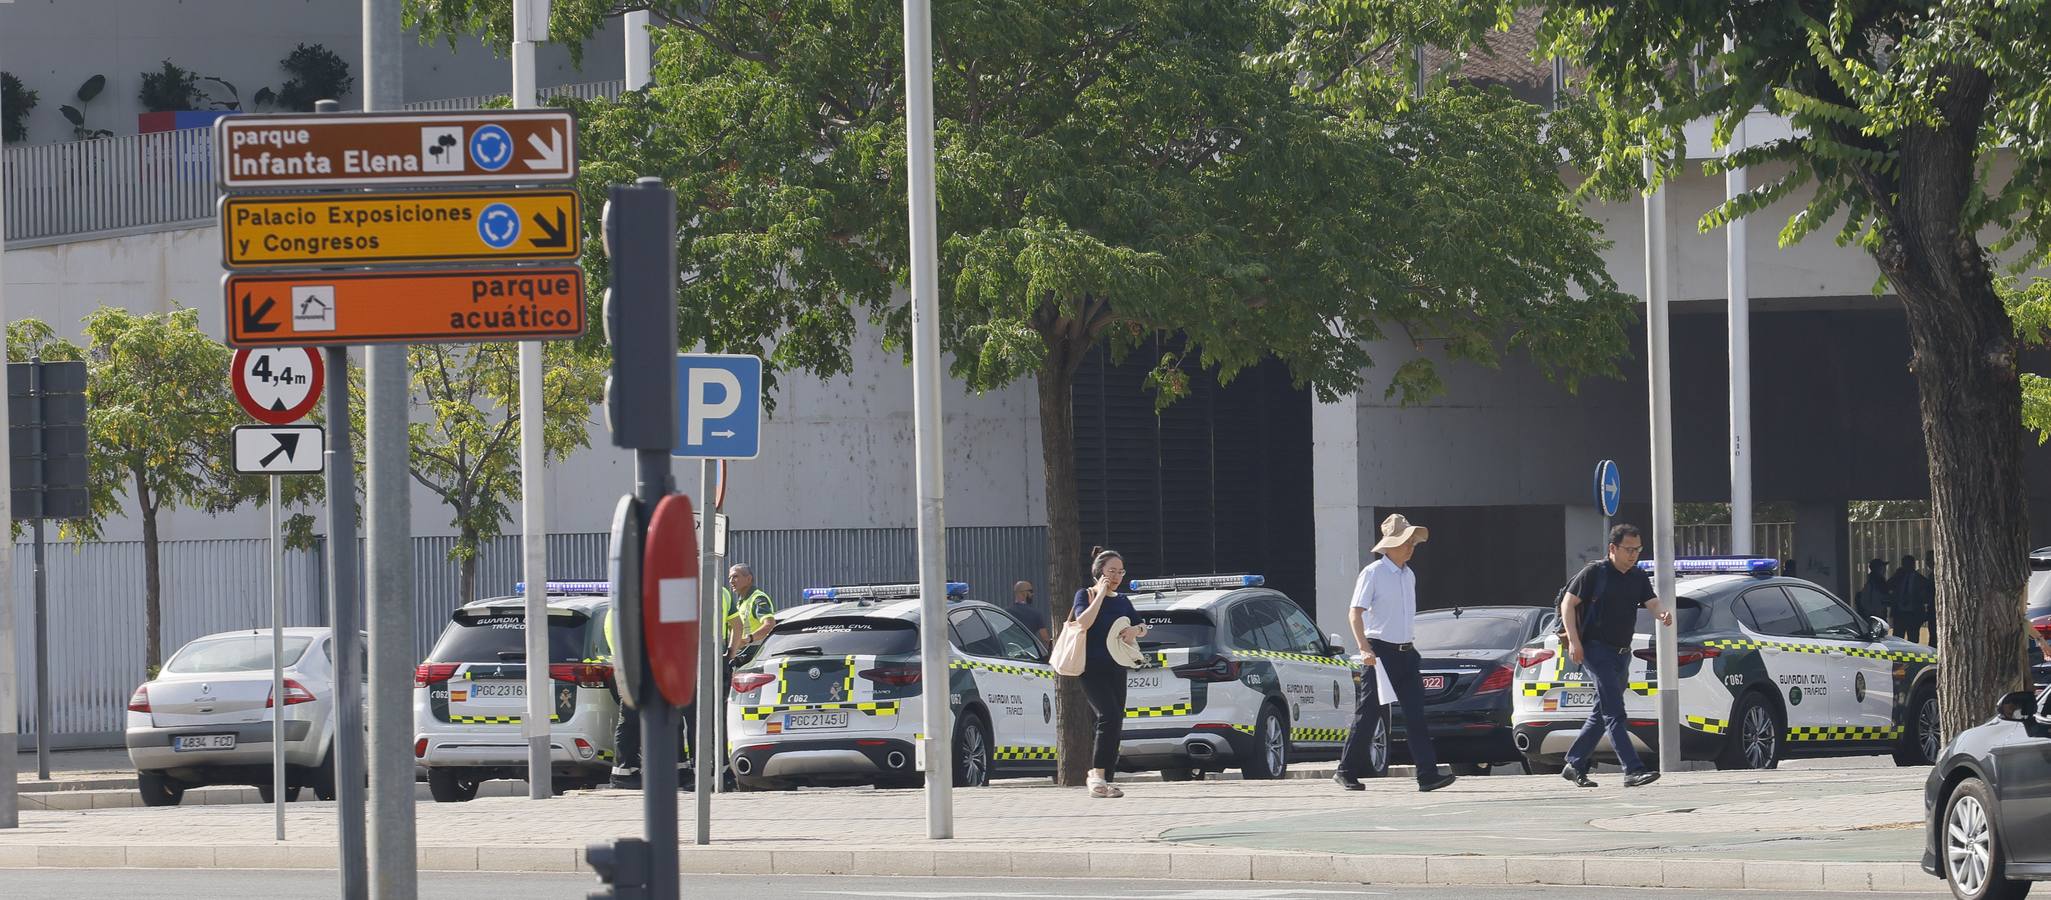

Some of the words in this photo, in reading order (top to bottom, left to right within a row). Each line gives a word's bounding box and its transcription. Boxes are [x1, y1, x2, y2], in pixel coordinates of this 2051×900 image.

[233, 129, 310, 149] parque
[233, 152, 331, 175] Infanta
[344, 150, 418, 173] Elena
[237, 207, 316, 225] Palacio
[328, 204, 472, 227] Exposiciones
[239, 239, 250, 255] y
[264, 234, 379, 254] Congresos
[472, 278, 570, 301] parque
[450, 304, 572, 329] acuático
[687, 367, 742, 446] P
[477, 617, 519, 625] GUARDIA
[1128, 678, 1151, 688] 2524
[1730, 673, 1743, 686] 062
[1779, 674, 1808, 684] GUARDIA
[1811, 674, 1827, 684] CIVIL
[476, 685, 495, 696] PGC
[498, 685, 523, 696] 2316
[794, 694, 808, 703] 062
[790, 715, 810, 727] PGC
[812, 714, 837, 726] 2145
[839, 713, 846, 724] U
[182, 737, 206, 748] 4834
